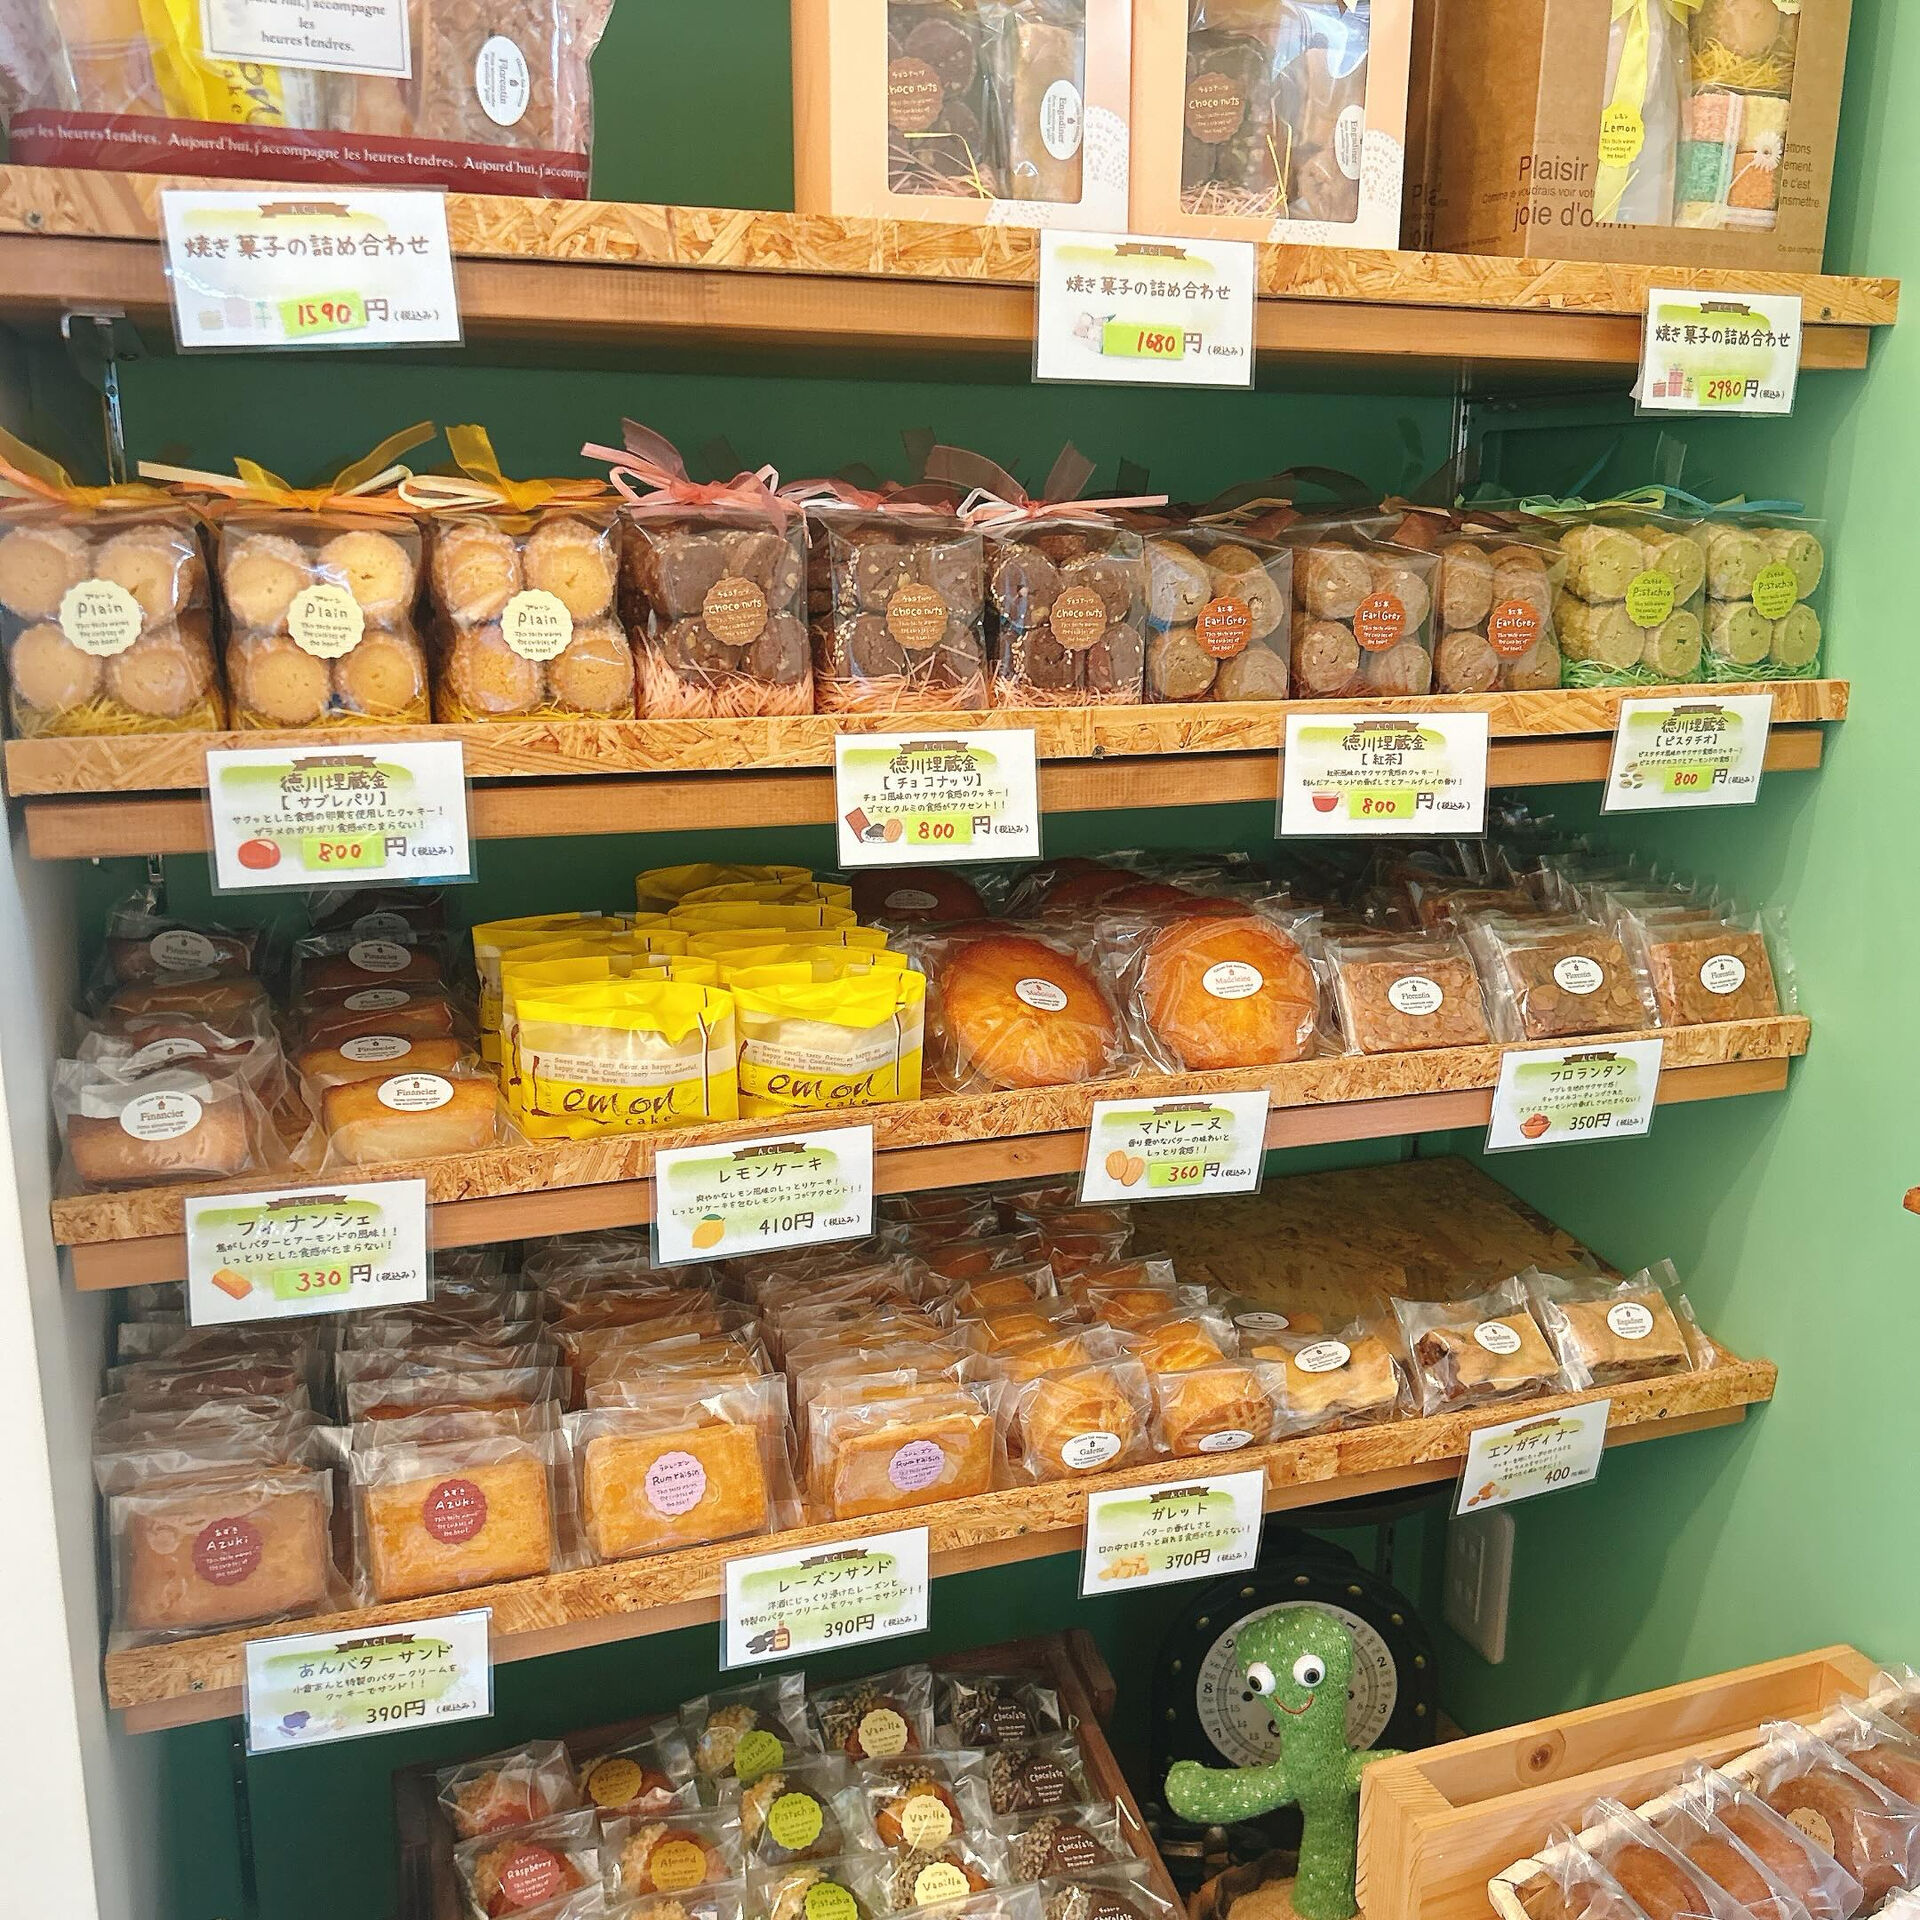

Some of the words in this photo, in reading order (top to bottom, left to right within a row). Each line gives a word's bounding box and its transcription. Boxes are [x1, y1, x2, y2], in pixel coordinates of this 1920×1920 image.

[298, 16, 315, 29] les
[261, 30, 303, 47] heures
[917, 83, 938, 94] nuts
[1220, 96, 1240, 106] nuts
[1603, 121, 1637, 133] Lemon
[57, 124, 104, 142] heures
[344, 147, 361, 161] les
[364, 149, 407, 165] heures
[407, 153, 458, 169] tendres.
[1518, 154, 1589, 182] Plaisir
[1558, 186, 1577, 198] voir
[1512, 199, 1552, 233] joie
[1633, 586, 1671, 598] Pistachio
[77, 602, 124, 619] Plain
[305, 602, 348, 619] Plain
[741, 599, 763, 611] nuts
[924, 606, 943, 616] nuts
[518, 611, 558, 628] Plain
[1085, 608, 1103, 618] nuts
[1362, 610, 1381, 621] Earl
[1381, 611, 1401, 622] Grey
[1204, 616, 1225, 627] Earl
[1226, 616, 1247, 628] Grey
[1496, 617, 1515, 629] Earl
[1516, 617, 1536, 628] Grey
[1661, 716, 1729, 734] 徳川埋蔵金
[1341, 734, 1428, 752] 徳川埋蔵金
[889, 754, 979, 775] 徳川埋蔵金
[280, 770, 390, 793] 徳川埋蔵金
[1215, 974, 1252, 985] Madeleine
[1401, 991, 1431, 1001] Florentin
[1550, 1064, 1628, 1082] フロランタン
[396, 1088, 437, 1097] Financier
[825, 1098, 869, 1108] cake
[140, 1109, 184, 1122] Financier
[625, 1115, 672, 1126] cake
[1569, 1112, 1611, 1131] 350円
[1138, 1116, 1222, 1135] マドレーヌ
[719, 1156, 822, 1184] レモンケーキ
[236, 1211, 371, 1237] フィナンシェ
[759, 1211, 814, 1236] 410円
[1079, 1445, 1105, 1456] Galette
[1487, 1428, 1580, 1460] エンガディナー
[895, 1459, 916, 1469] Rum
[916, 1455, 941, 1465] raisin
[652, 1475, 673, 1486] Rum
[674, 1468, 700, 1480] raisin
[435, 1497, 475, 1511] Azuki
[1151, 1501, 1208, 1521] ガレット
[206, 1535, 249, 1551] Azuki
[1165, 1548, 1211, 1570] 370円
[779, 1559, 893, 1594] レーズンサンド
[823, 1613, 875, 1639] 390円
[298, 1644, 454, 1679] あんバターサンド
[1376, 1656, 1388, 1668] 2
[1203, 1682, 1214, 1694] 8
[366, 1698, 426, 1724] 390円
[1378, 1704, 1387, 1714] 3
[993, 1711, 1027, 1722] Chocolate
[865, 1722, 901, 1736] Vanilla
[1029, 1770, 1064, 1783] Chocolate
[774, 1806, 816, 1824] Pistachio
[909, 1809, 946, 1823] Vanilla
[1057, 1840, 1095, 1853] Chocolate
[660, 1856, 697, 1868] Almond
[506, 1859, 552, 1880] Raspberry
[922, 1877, 962, 1892] Vanilla
[811, 1897, 850, 1910] Pistachio
